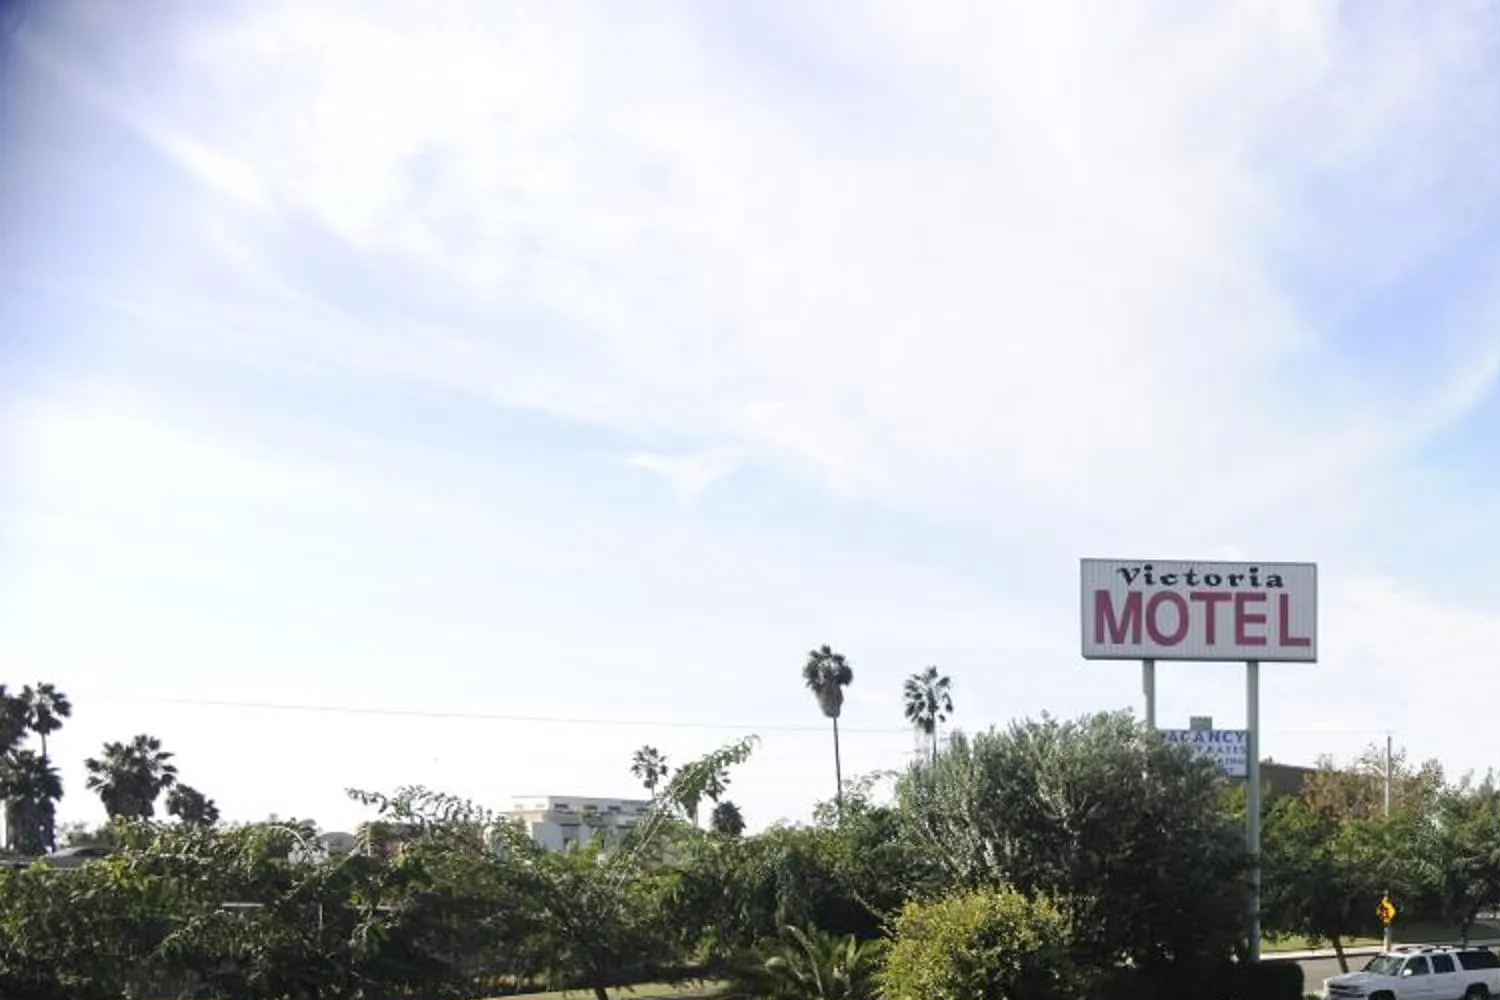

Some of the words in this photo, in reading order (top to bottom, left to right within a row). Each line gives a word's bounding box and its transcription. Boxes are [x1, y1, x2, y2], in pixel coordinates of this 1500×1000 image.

[1117, 564, 1285, 588] Victoria
[1093, 589, 1312, 647] MOTEL
[1160, 730, 1246, 743] ACANCY
